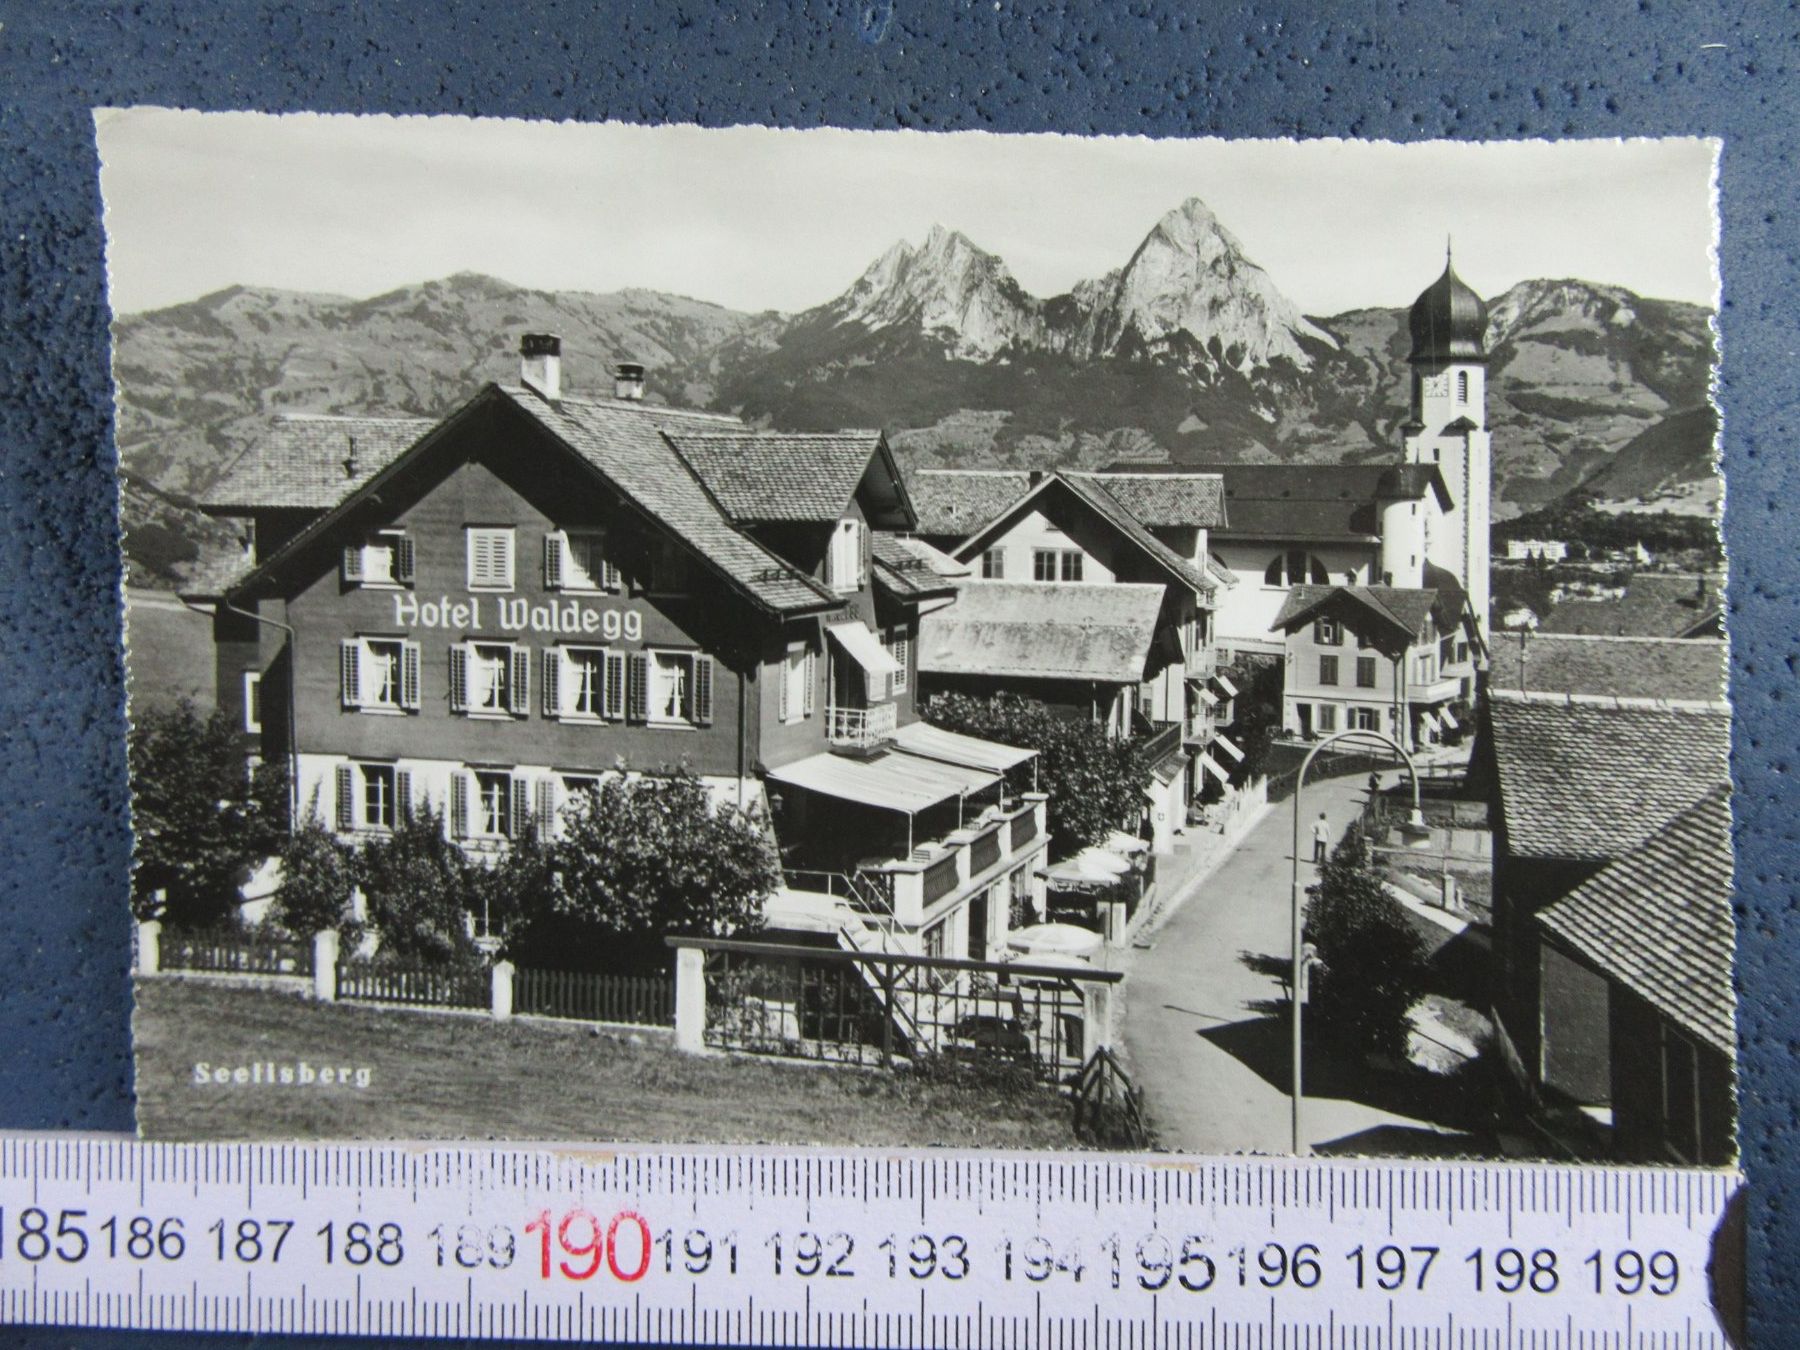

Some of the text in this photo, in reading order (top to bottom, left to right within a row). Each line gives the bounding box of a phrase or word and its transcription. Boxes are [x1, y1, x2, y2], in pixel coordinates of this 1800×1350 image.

[393, 592, 643, 641] Hotel Waldegg
[100, 1216, 186, 1260] 186
[208, 1218, 295, 1263] 187
[317, 1221, 404, 1267] 188
[427, 1223, 516, 1269] 189
[524, 1208, 652, 1283] 190
[655, 1228, 738, 1274] 191
[764, 1231, 855, 1277] 192
[878, 1233, 970, 1280] 193
[994, 1233, 1086, 1283] 194
[1100, 1232, 1216, 1292] 195
[1227, 1241, 1322, 1289] 196
[1346, 1245, 1440, 1290] 197
[1465, 1247, 1560, 1294] 198
[1584, 1249, 1680, 1296] 199
